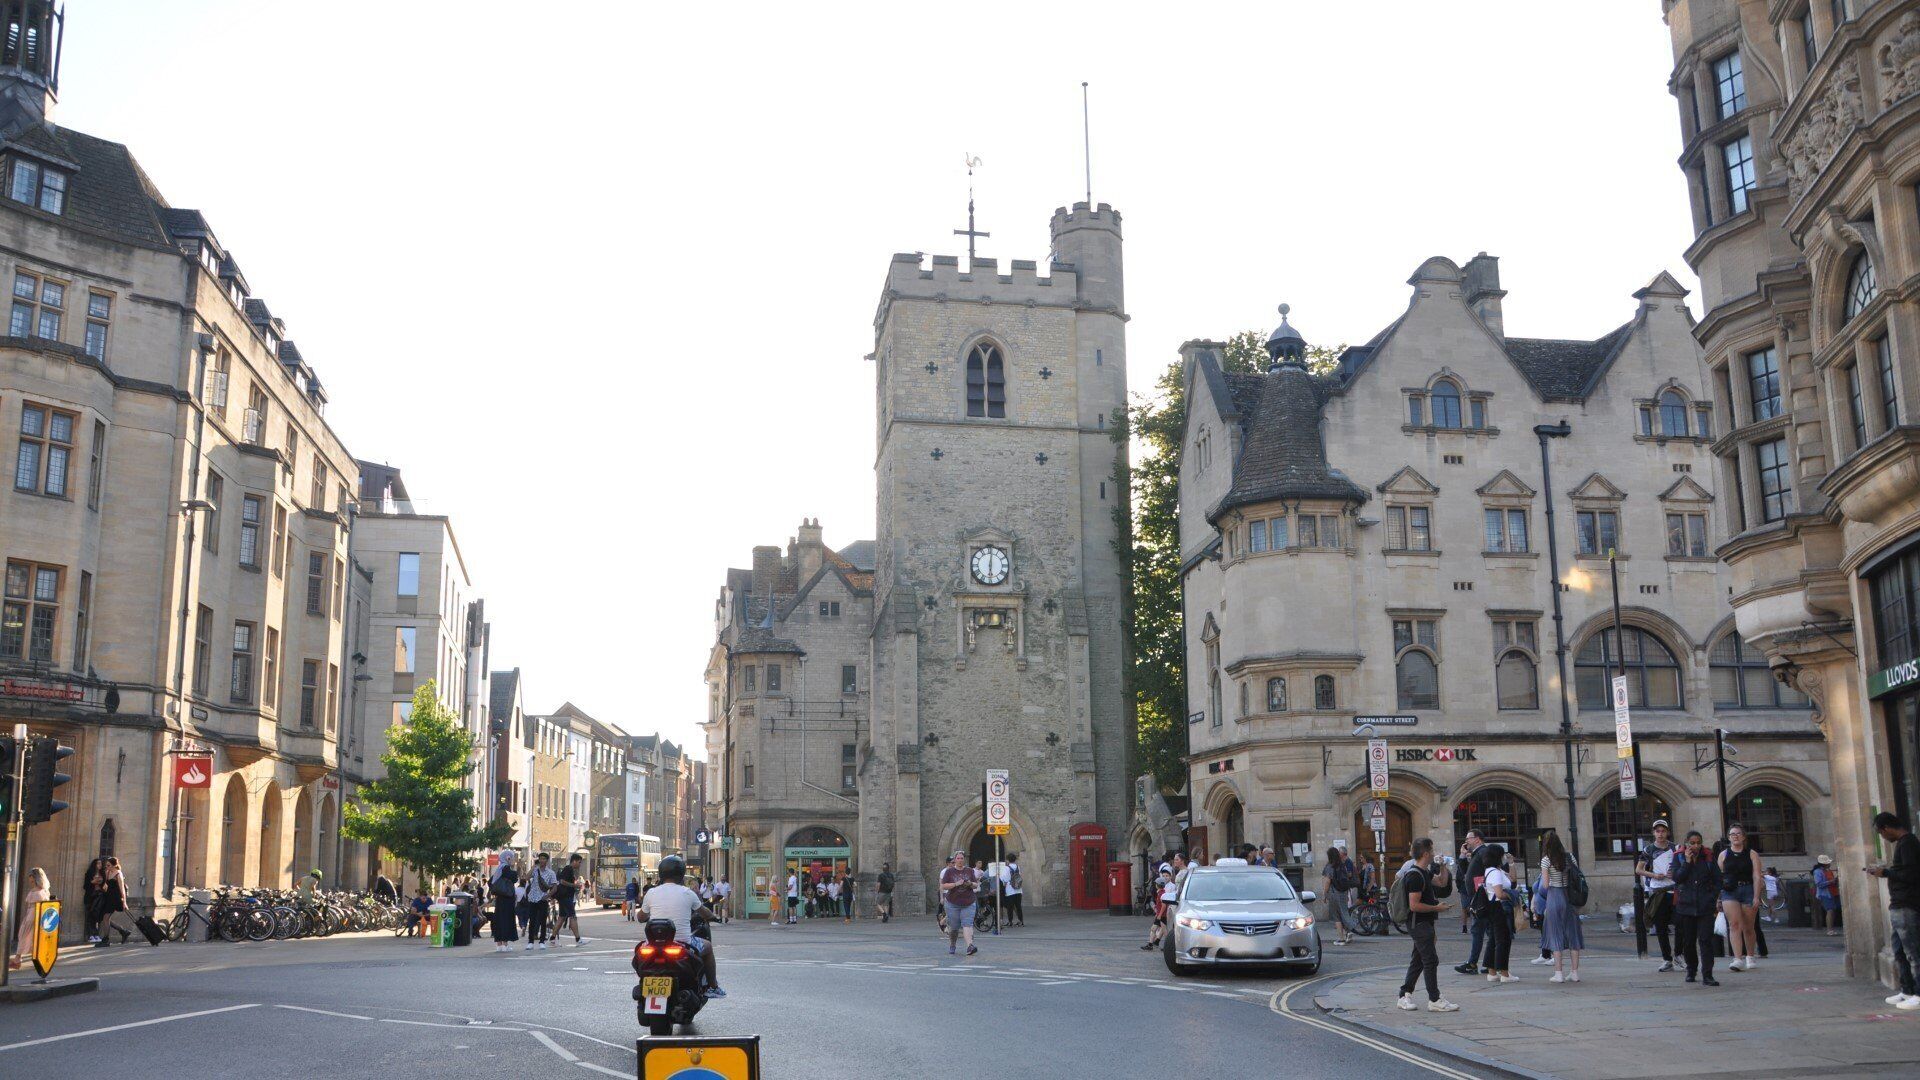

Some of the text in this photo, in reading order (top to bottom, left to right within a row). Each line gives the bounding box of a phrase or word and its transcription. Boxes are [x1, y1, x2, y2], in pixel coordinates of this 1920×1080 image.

[1886, 660, 1918, 688] LLOYDS
[1395, 748, 1477, 762] HSBC UK
[645, 979, 670, 987] LF20
[650, 997, 661, 1010] L
